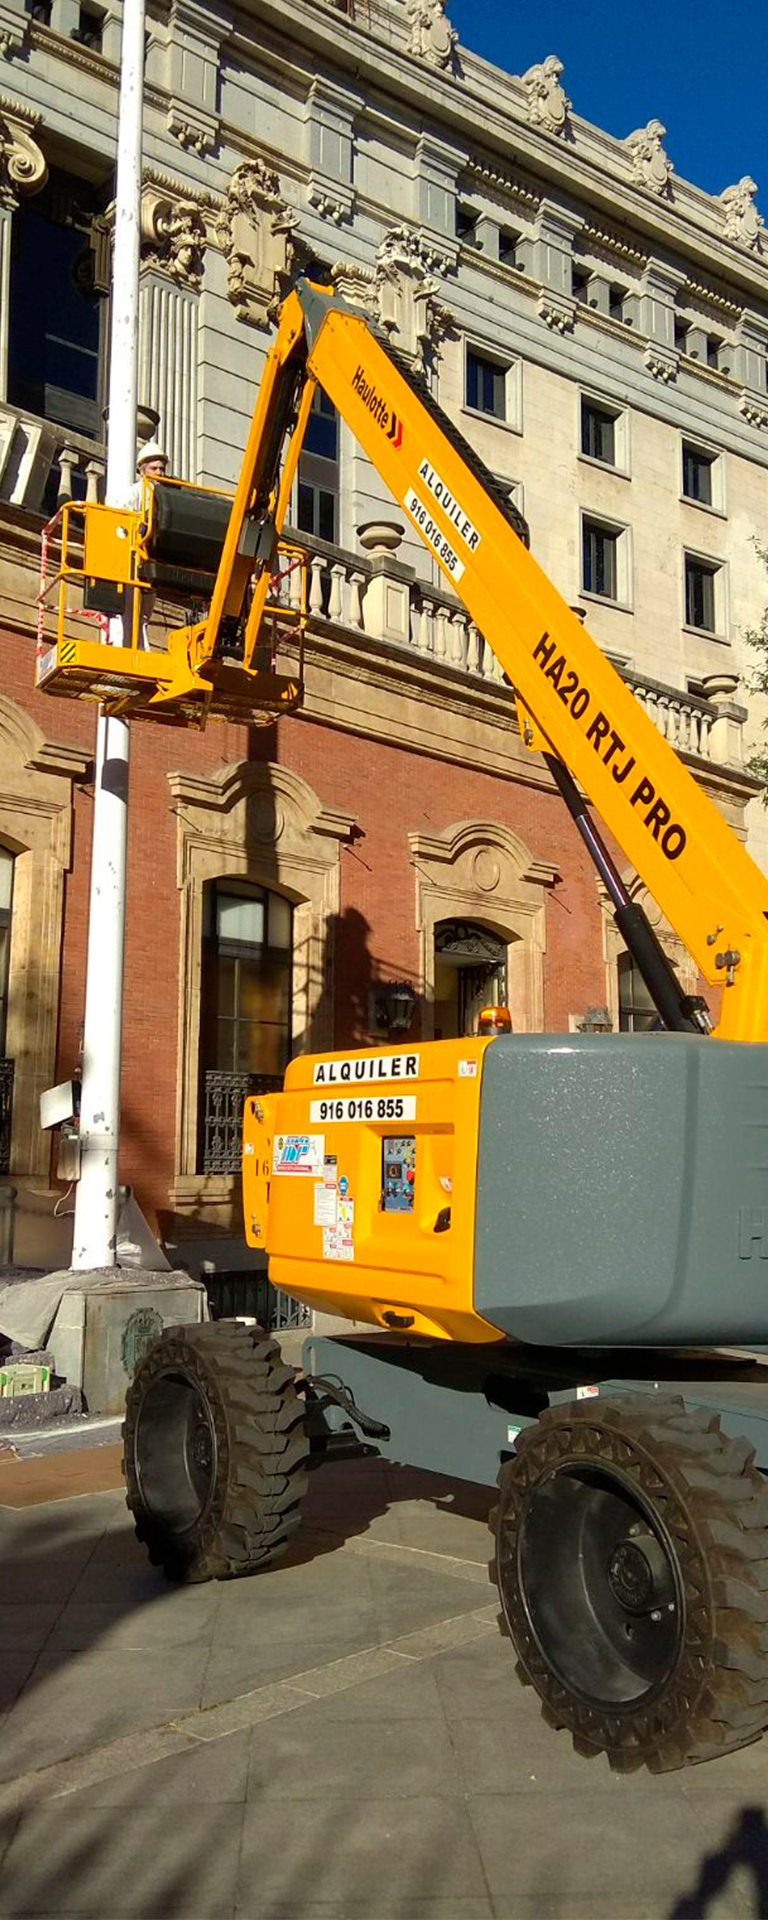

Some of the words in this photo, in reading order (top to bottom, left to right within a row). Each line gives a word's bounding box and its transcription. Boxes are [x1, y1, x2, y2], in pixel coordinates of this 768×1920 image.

[352, 364, 389, 429] Haulotte
[409, 497, 426, 524] 916
[424, 521, 441, 547] 016
[439, 544, 459, 572] 855
[419, 462, 479, 551] ALQUILER
[532, 631, 590, 720] HA20
[586, 711, 636, 783] RTJ
[630, 777, 686, 860] PRO
[315, 1056, 418, 1082] ALQUILER
[319, 1101, 344, 1120] 916
[347, 1100, 373, 1120] 016
[376, 1098, 404, 1119] 855
